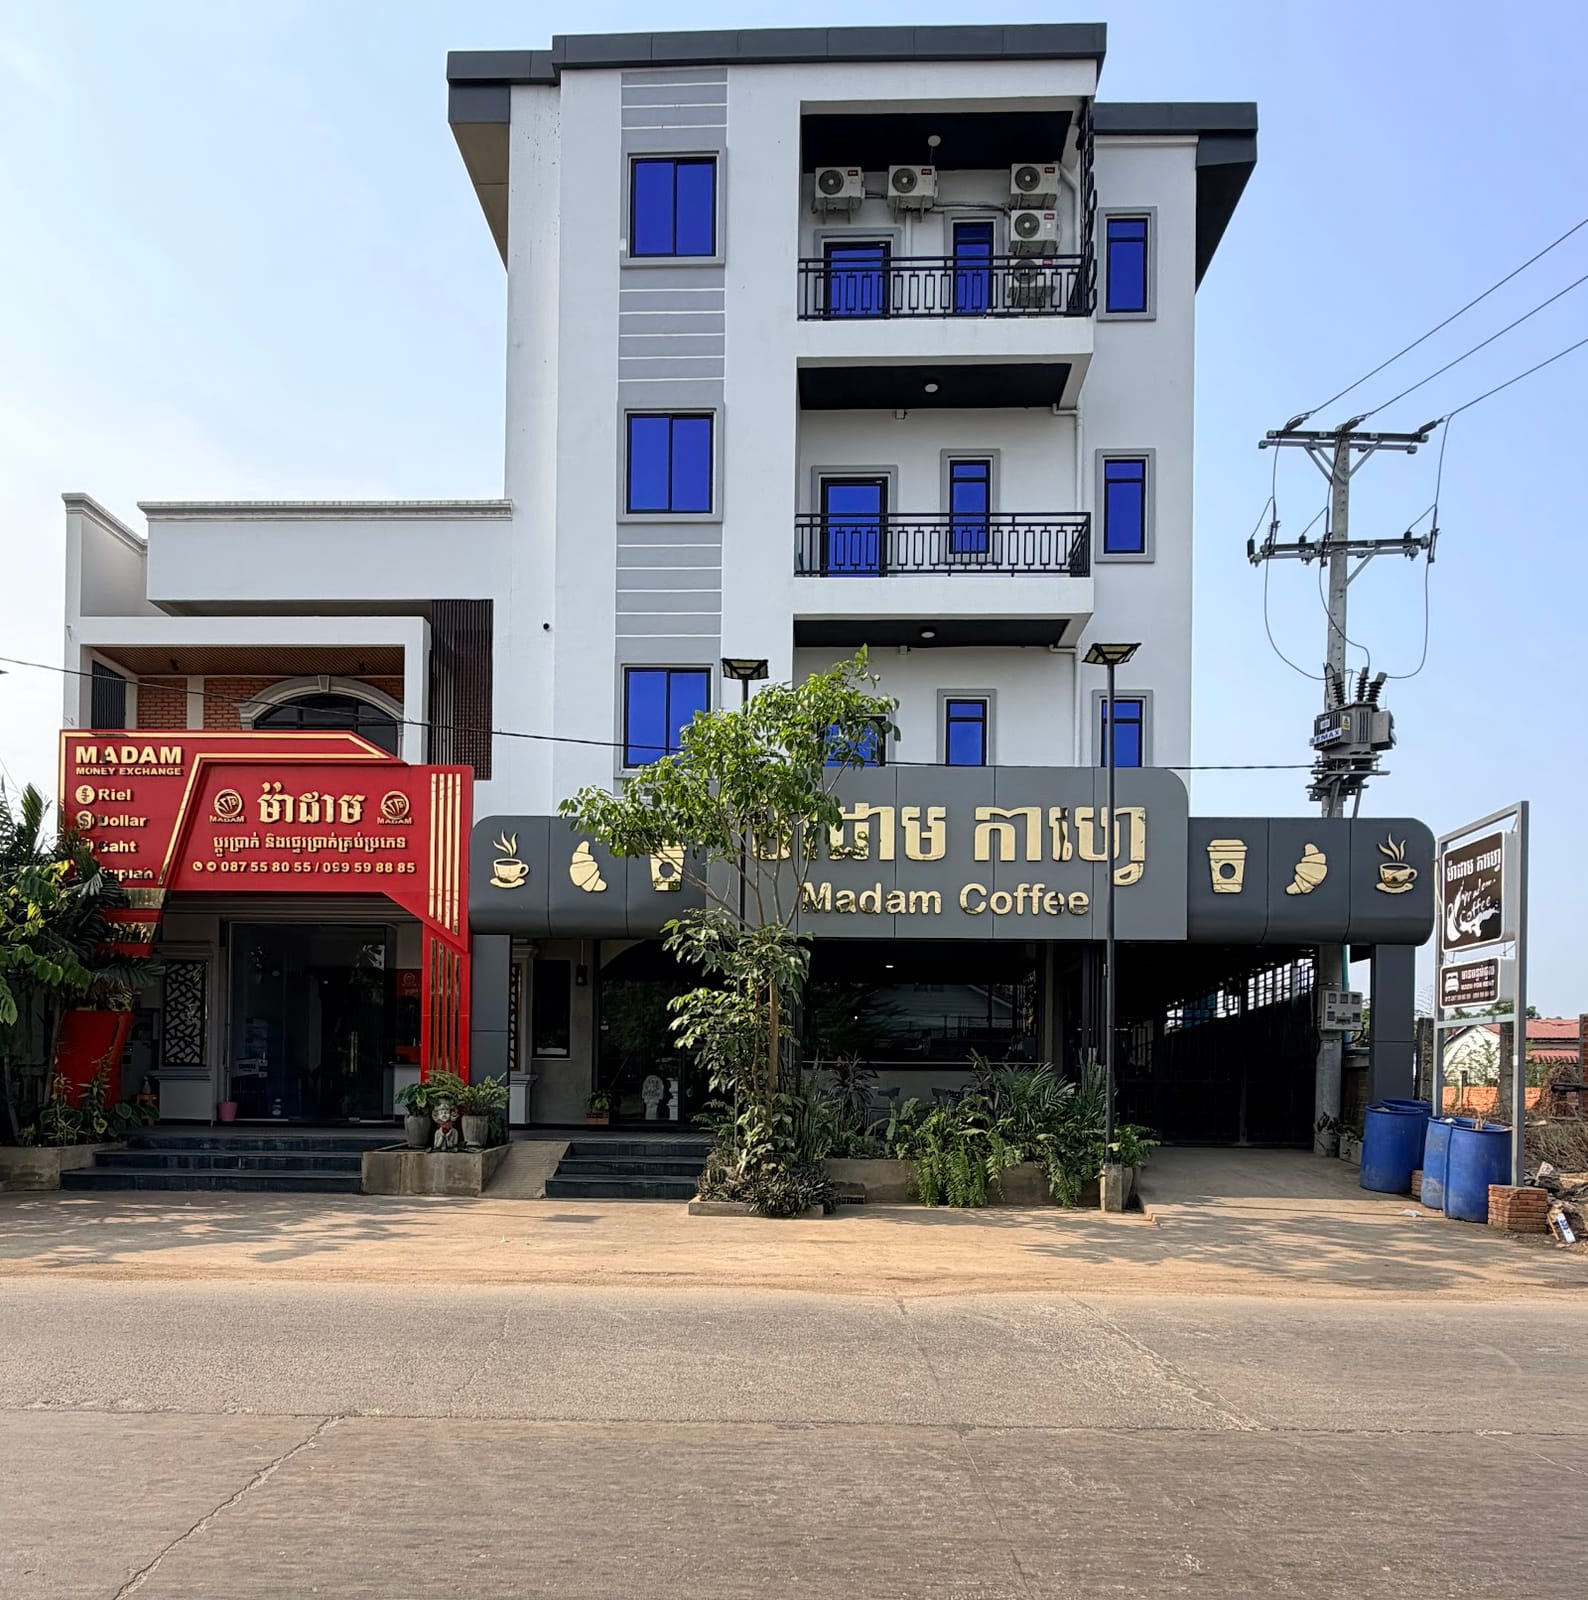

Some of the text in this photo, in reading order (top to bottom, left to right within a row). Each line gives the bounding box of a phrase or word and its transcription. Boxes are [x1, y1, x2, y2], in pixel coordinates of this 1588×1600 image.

[75, 746, 182, 764] MADAM
[76, 767, 182, 776] MONEY EXCHANGE
[98, 788, 132, 801] Riel
[98, 814, 148, 827] Dollar
[209, 815, 245, 823] MADAM
[377, 816, 412, 825] MADAM
[221, 861, 248, 872] 087
[250, 861, 268, 872] 55
[272, 861, 290, 872] 80
[294, 861, 312, 872] 55
[323, 862, 350, 873] 099
[354, 862, 372, 873] 59
[376, 862, 393, 873] 88
[397, 862, 415, 873] 85
[99, 867, 153, 882] piah
[801, 882, 1091, 916] Madam Coffee
